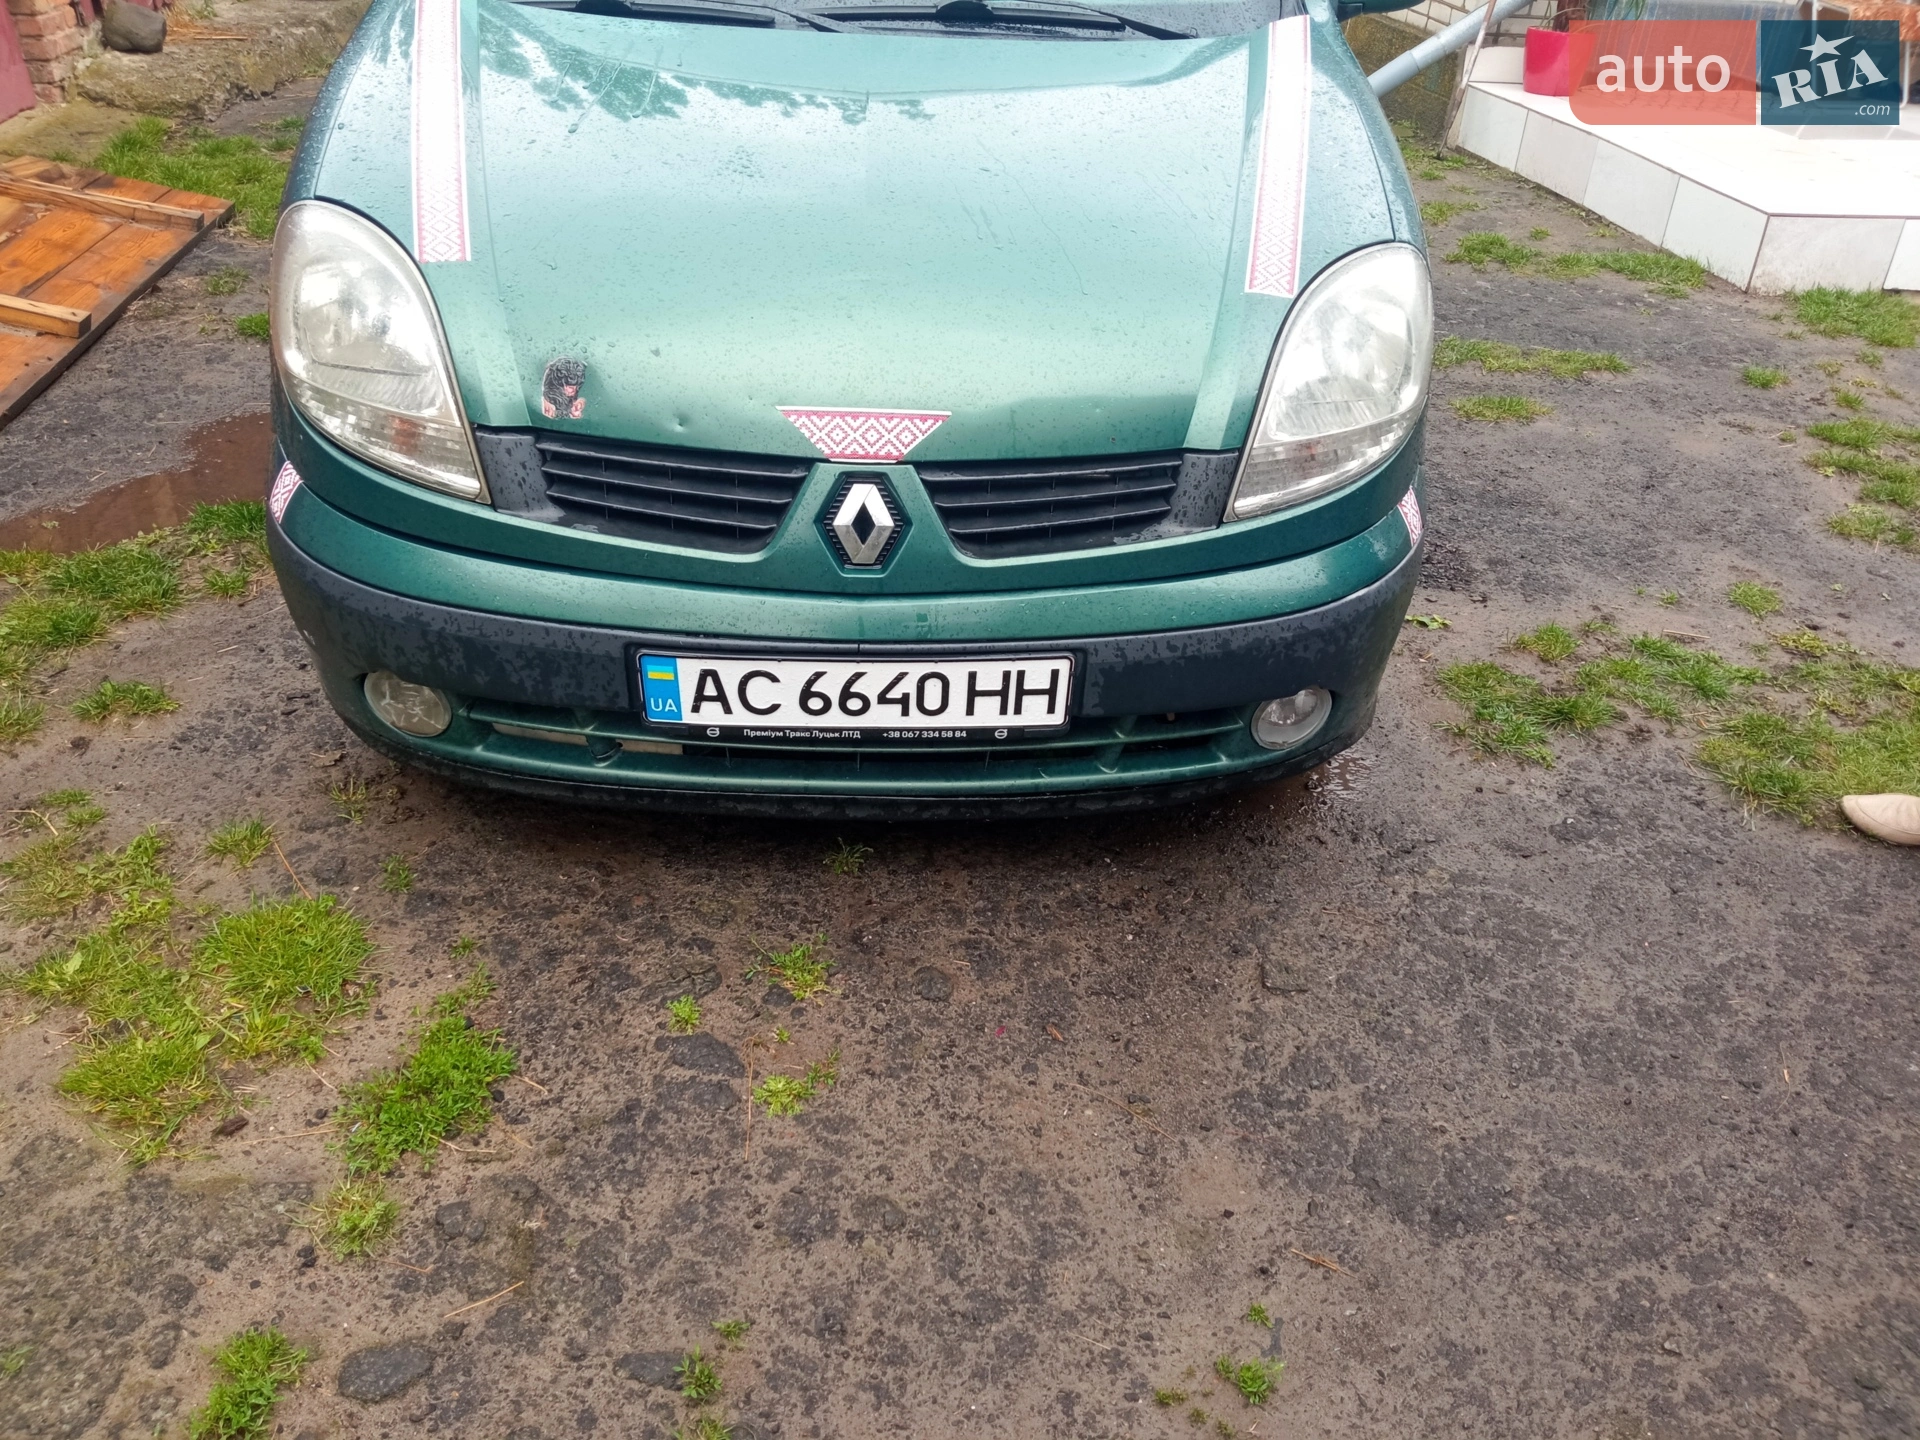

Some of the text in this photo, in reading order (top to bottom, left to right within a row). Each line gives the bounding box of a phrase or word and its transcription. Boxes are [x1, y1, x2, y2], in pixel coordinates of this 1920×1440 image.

[690, 668, 1060, 717] AC 6640 HH
[650, 696, 678, 713] UA
[743, 728, 861, 739] Преміум Тракс Луцьк ЛТД
[882, 730, 967, 738] +38 067 334 58 84
